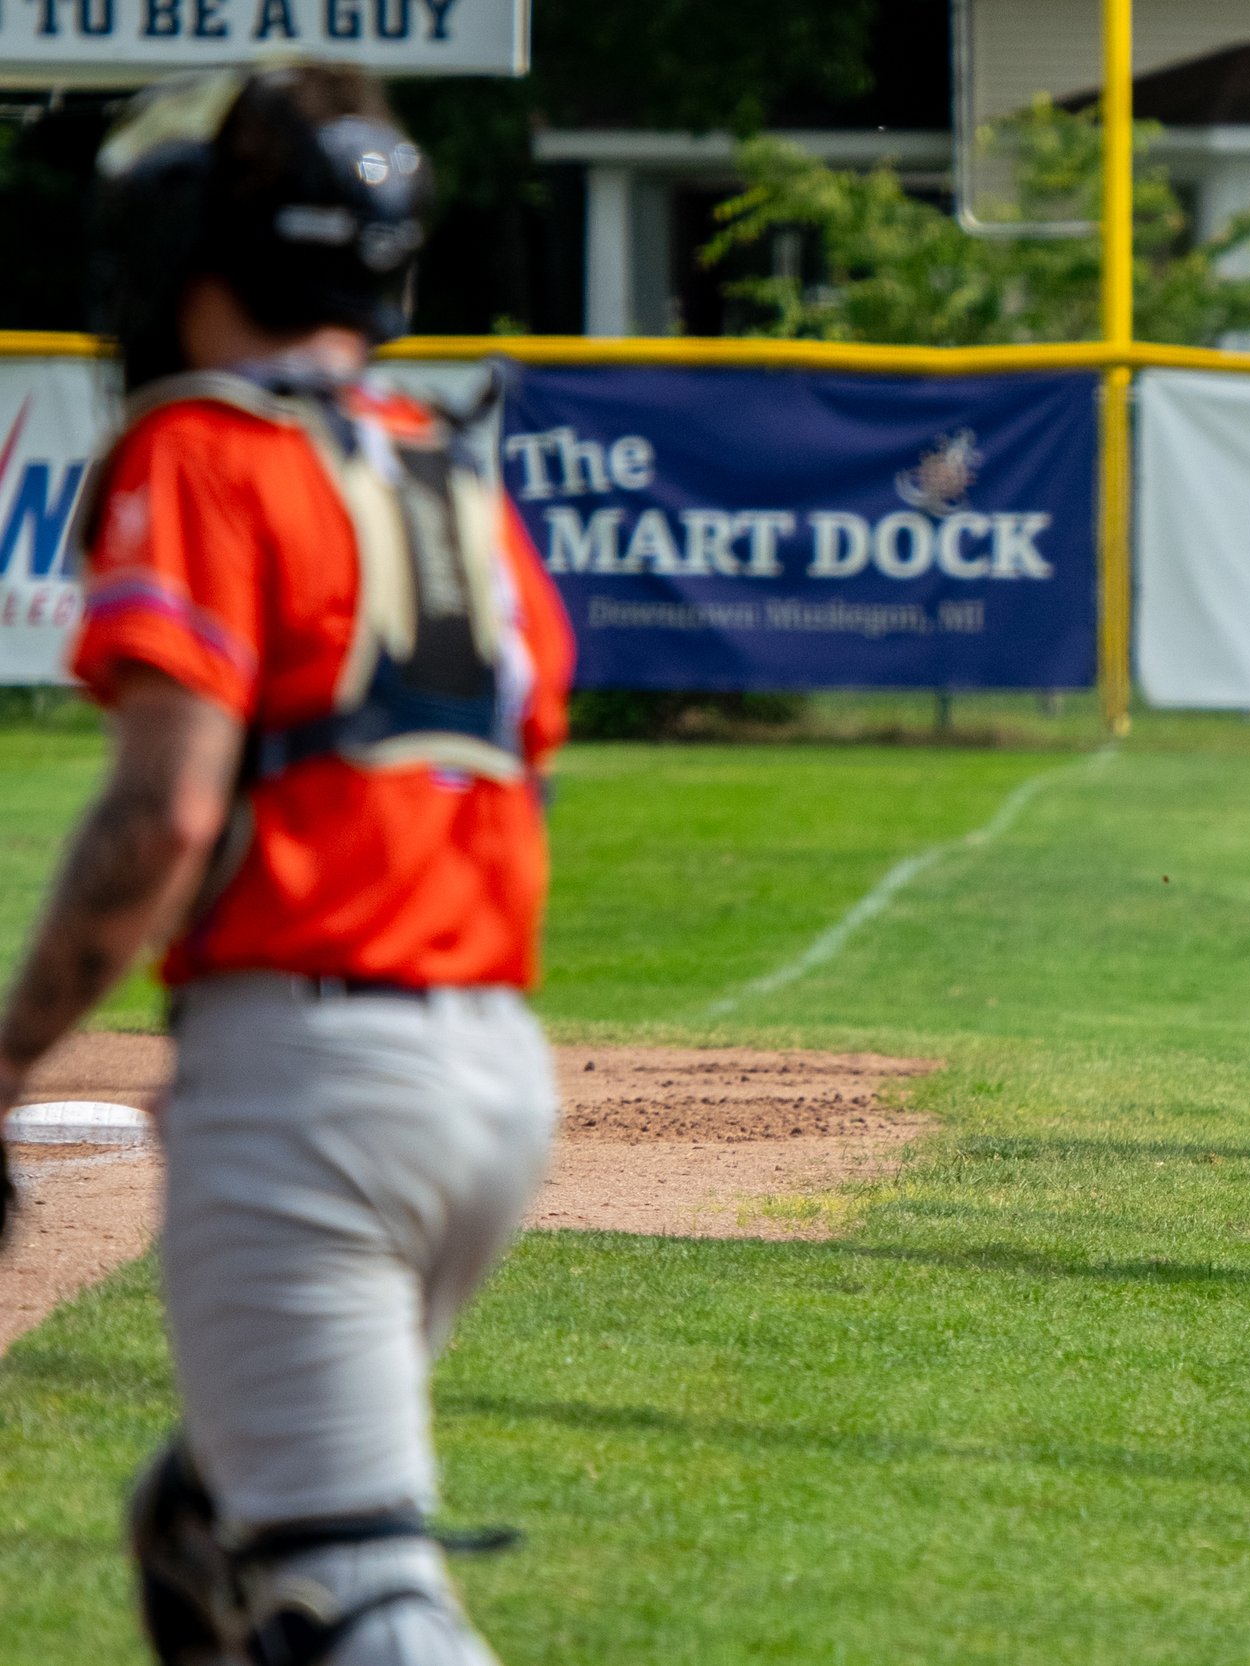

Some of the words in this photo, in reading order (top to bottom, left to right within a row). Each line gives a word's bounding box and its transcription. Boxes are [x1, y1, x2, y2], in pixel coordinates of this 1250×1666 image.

[22, 0, 114, 37] TO
[142, 0, 230, 38] BE
[253, 0, 299, 39] A
[324, 0, 460, 40] GUY
[505, 426, 653, 500] The
[545, 507, 795, 577] MART
[806, 511, 1052, 579] DOCK
